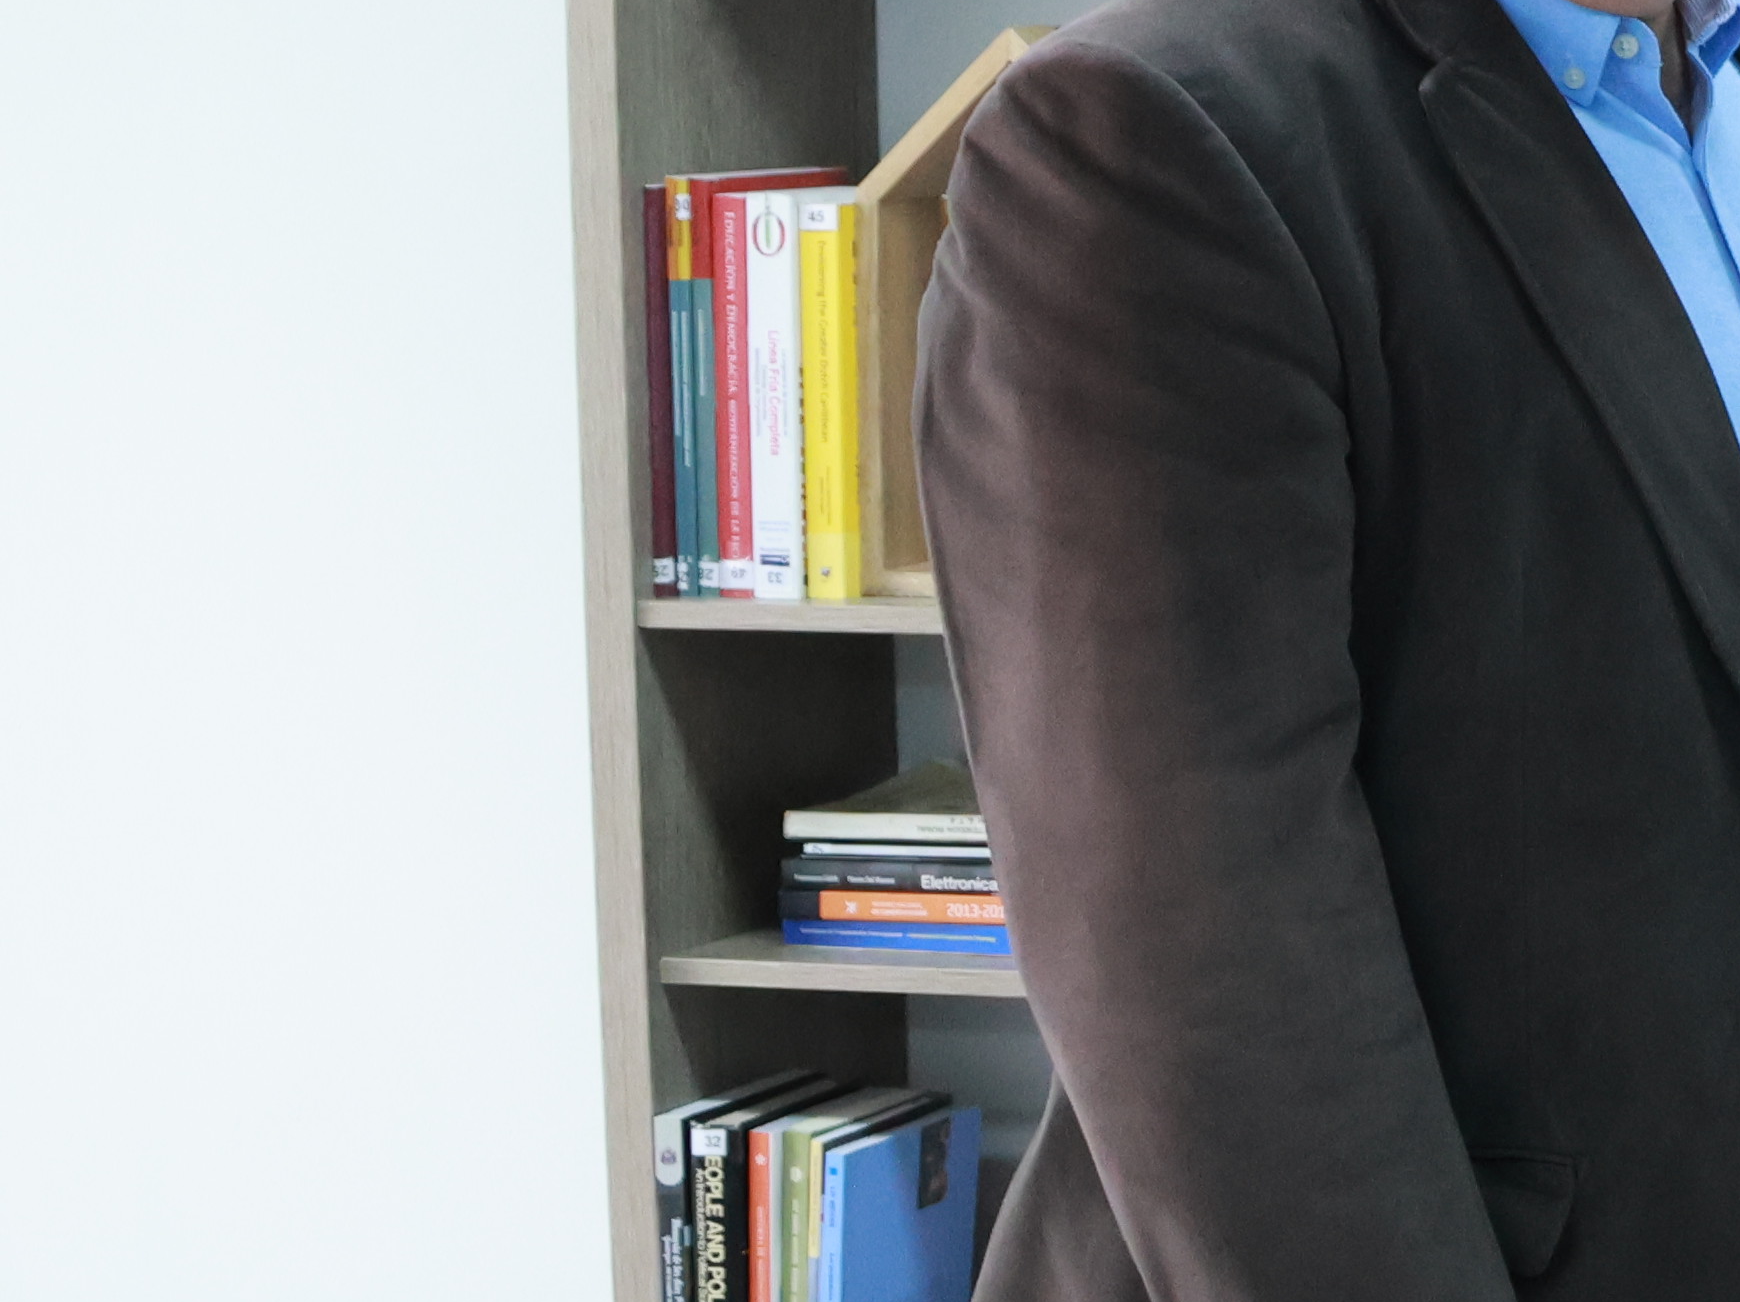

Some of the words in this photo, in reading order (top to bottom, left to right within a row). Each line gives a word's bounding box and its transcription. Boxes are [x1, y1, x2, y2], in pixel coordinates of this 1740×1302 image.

[807, 210, 825, 223] 45
[723, 211, 738, 290] EDUCACIÓN
[767, 397, 781, 456] Completa
[766, 571, 784, 584] 33
[920, 875, 999, 892] Elettronica
[704, 1155, 725, 1220] EOPLE
[696, 1182, 706, 1237] Introduction
[705, 1222, 725, 1263] AND
[697, 1250, 708, 1288] Political
